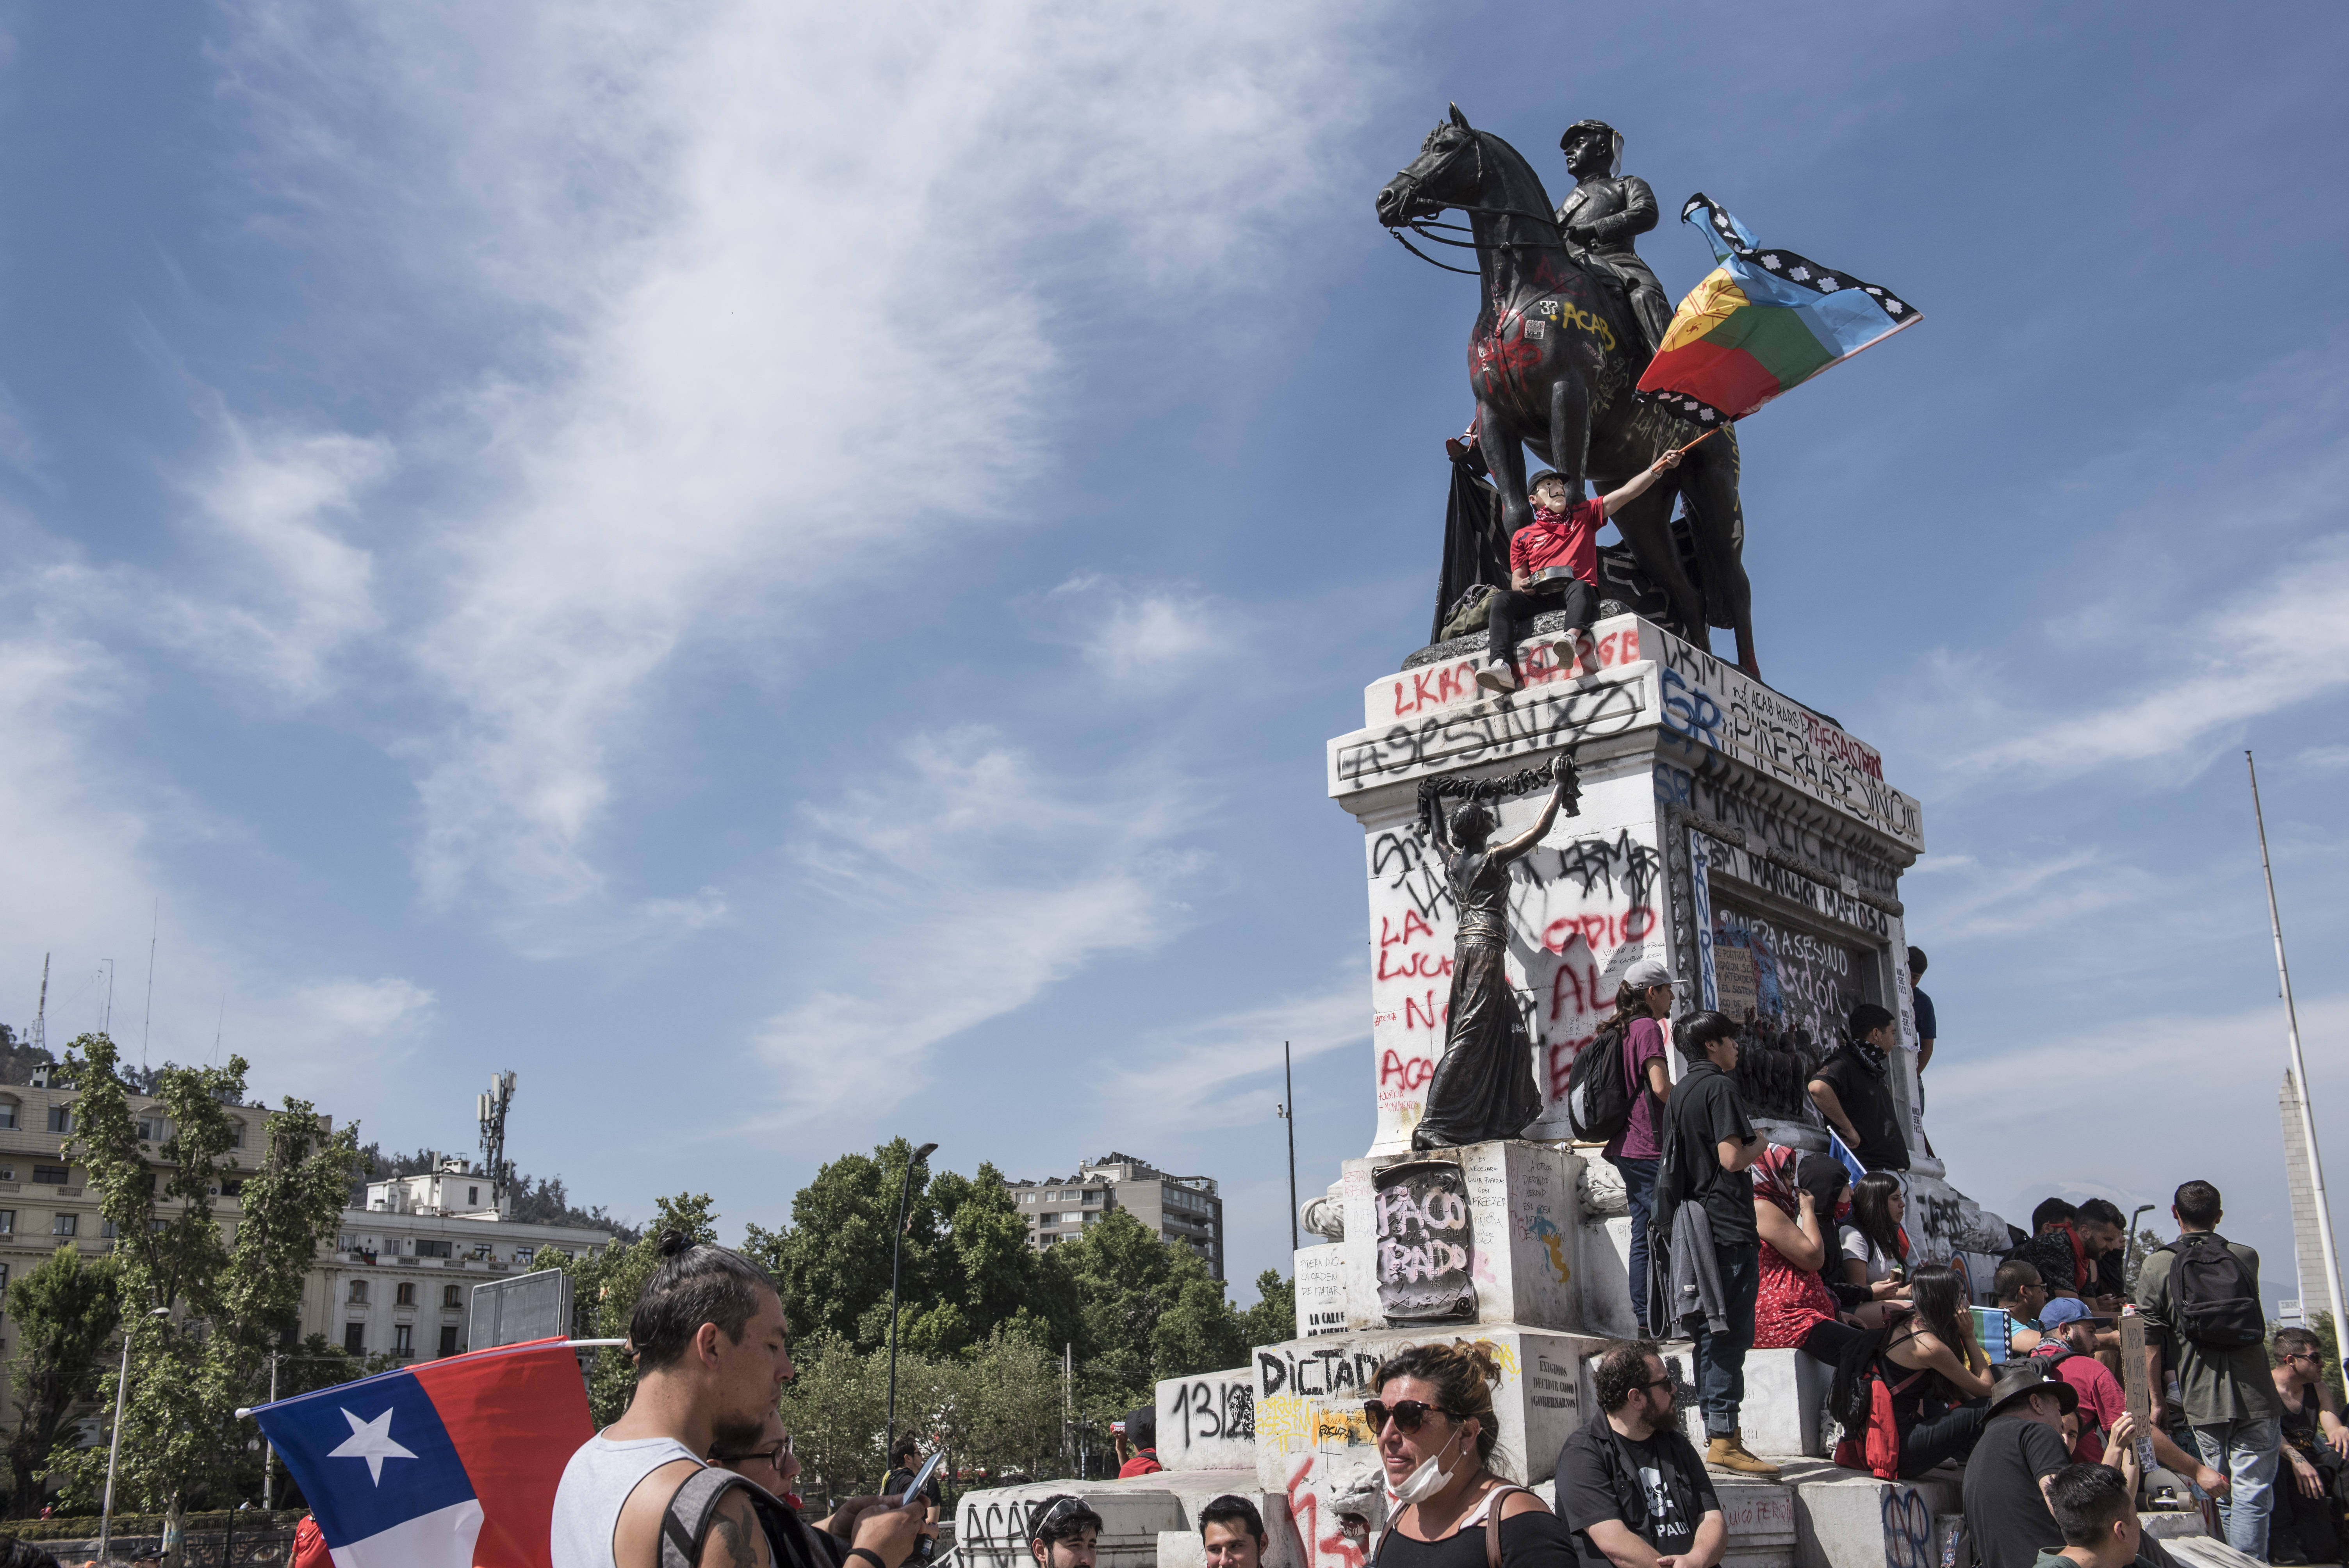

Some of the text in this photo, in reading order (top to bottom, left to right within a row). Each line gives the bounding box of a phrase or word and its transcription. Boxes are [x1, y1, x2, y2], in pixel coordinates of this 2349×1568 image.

[1380, 909, 1434, 948] LA
[1542, 905, 1656, 953] ODIO
[1782, 931, 1848, 976] ASESINO
[1472, 1196, 1508, 1208] FREEZER
[1406, 1228, 1461, 1241] CABALLERIA
[1301, 1272, 1338, 1282] LA ORDEN
[1426, 1266, 1454, 1276] RESERVA
[1427, 1279, 1442, 1288] 1943
[1301, 1287, 1312, 1296] DE
[1310, 1311, 1345, 1325] LA CALLE
[1539, 1360, 1567, 1377] EXIGIMOS
[1533, 1377, 1574, 1394] DECIDIR COMO
[1533, 1395, 1576, 1408] GOBERNARNOS
